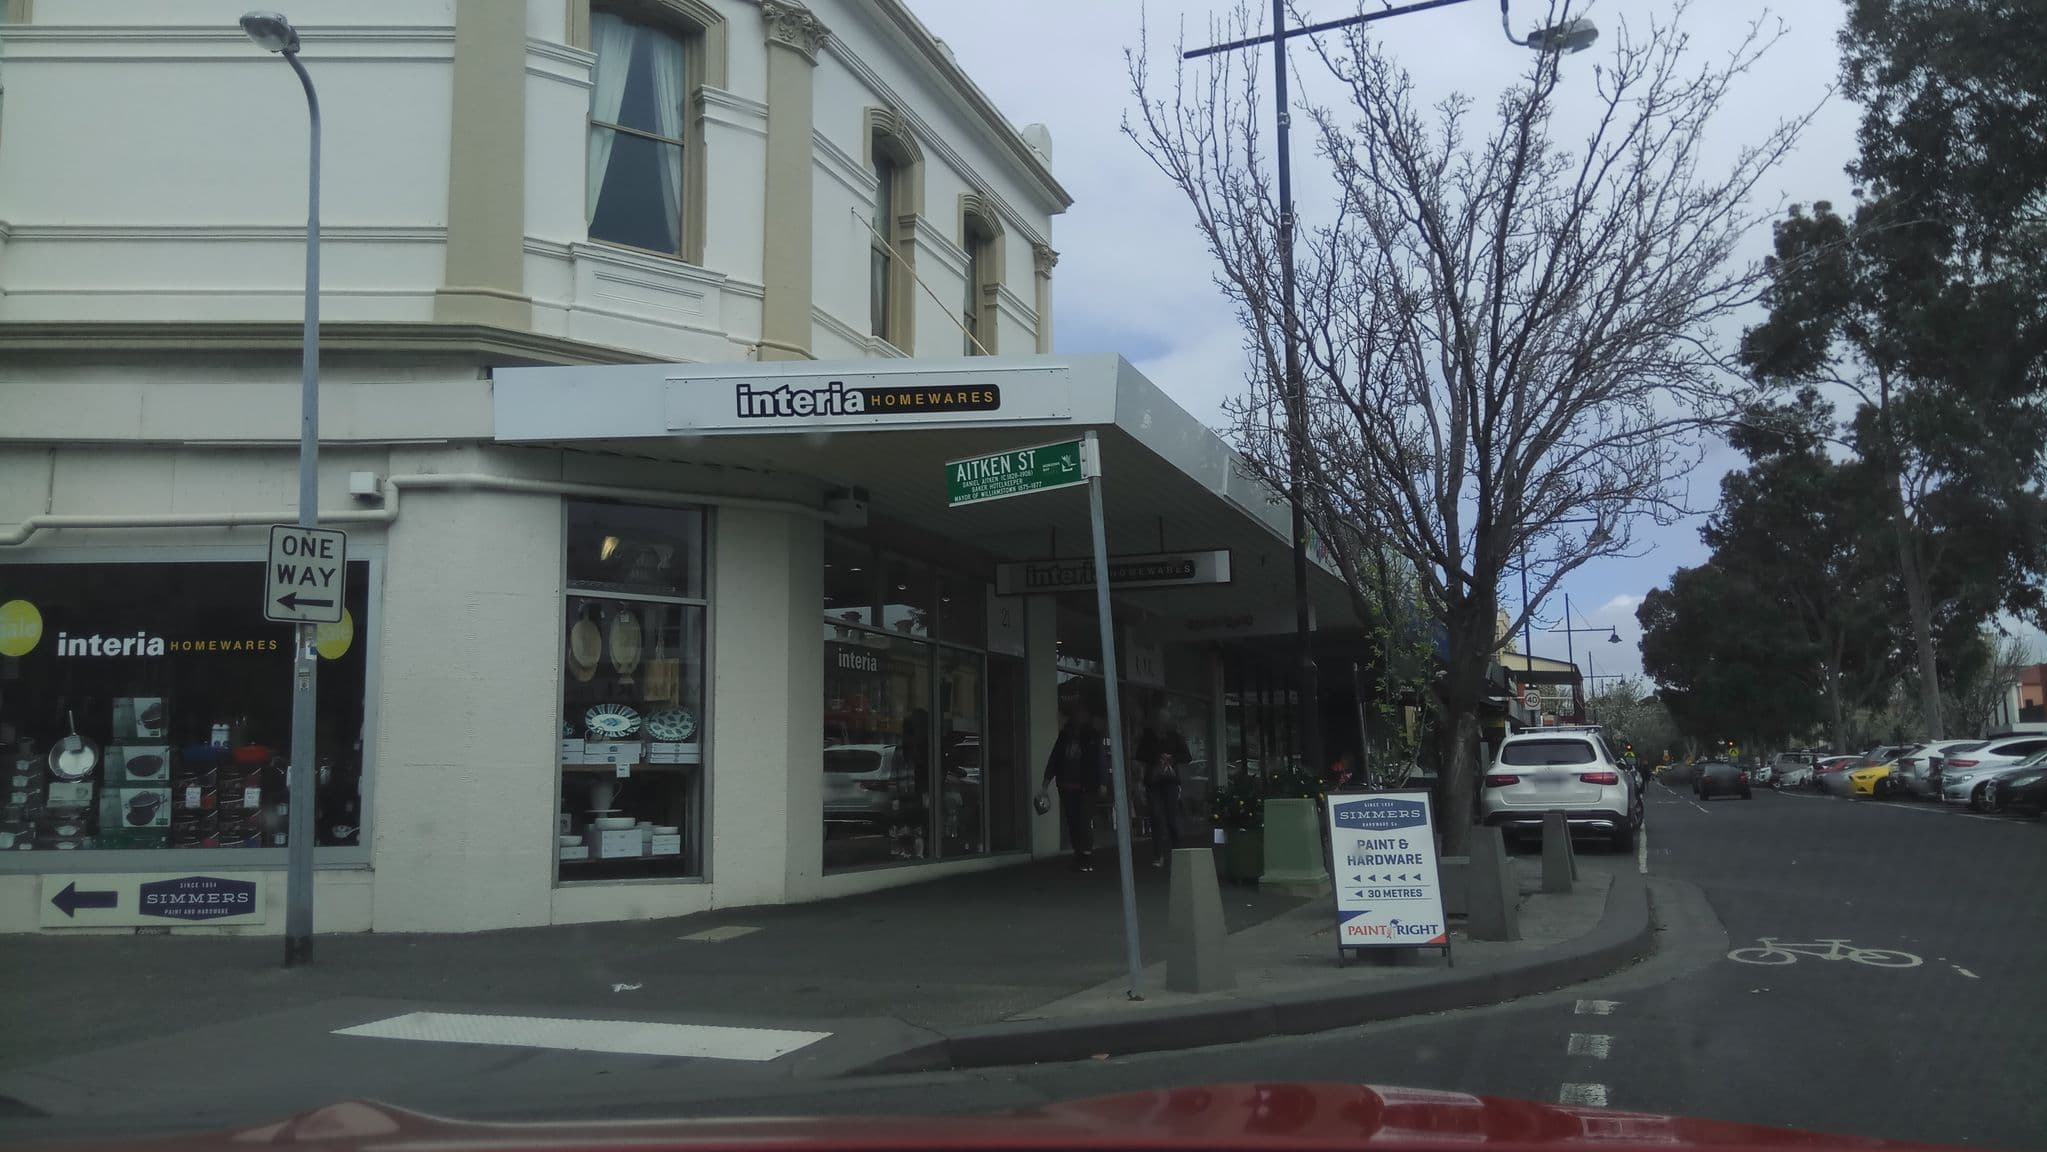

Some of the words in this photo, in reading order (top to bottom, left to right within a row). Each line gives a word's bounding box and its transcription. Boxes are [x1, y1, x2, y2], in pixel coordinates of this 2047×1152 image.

[736, 382, 865, 418] interia
[871, 391, 993, 406] HOMEWARES
[957, 455, 1012, 482] AITKEN
[1018, 450, 1037, 470] ST
[962, 479, 980, 488] DANIEL
[981, 476, 999, 485] AITKEN
[989, 478, 1023, 491] HOTELKEEPER
[954, 493, 971, 502] MAYOR
[971, 492, 979, 500] OF
[981, 485, 1017, 498] WILLIAMSTOWN
[282, 535, 333, 560] ONE
[277, 563, 336, 588] WAY
[1027, 562, 1097, 587] interi
[57, 631, 165, 656] interia
[170, 639, 278, 651] HOMEWARES
[838, 647, 877, 672] interia
[1527, 696, 1538, 704] 40
[1340, 809, 1421, 820] SIMMERS
[1357, 839, 1396, 850] PAINT
[1398, 838, 1409, 849] &
[1347, 854, 1423, 866] HARDWARE
[146, 892, 249, 904] SIMMERS
[1368, 889, 1381, 898] 30
[1383, 889, 1423, 898] METRES
[1348, 925, 1387, 935] PAINT
[1397, 924, 1438, 935] RIGHT
